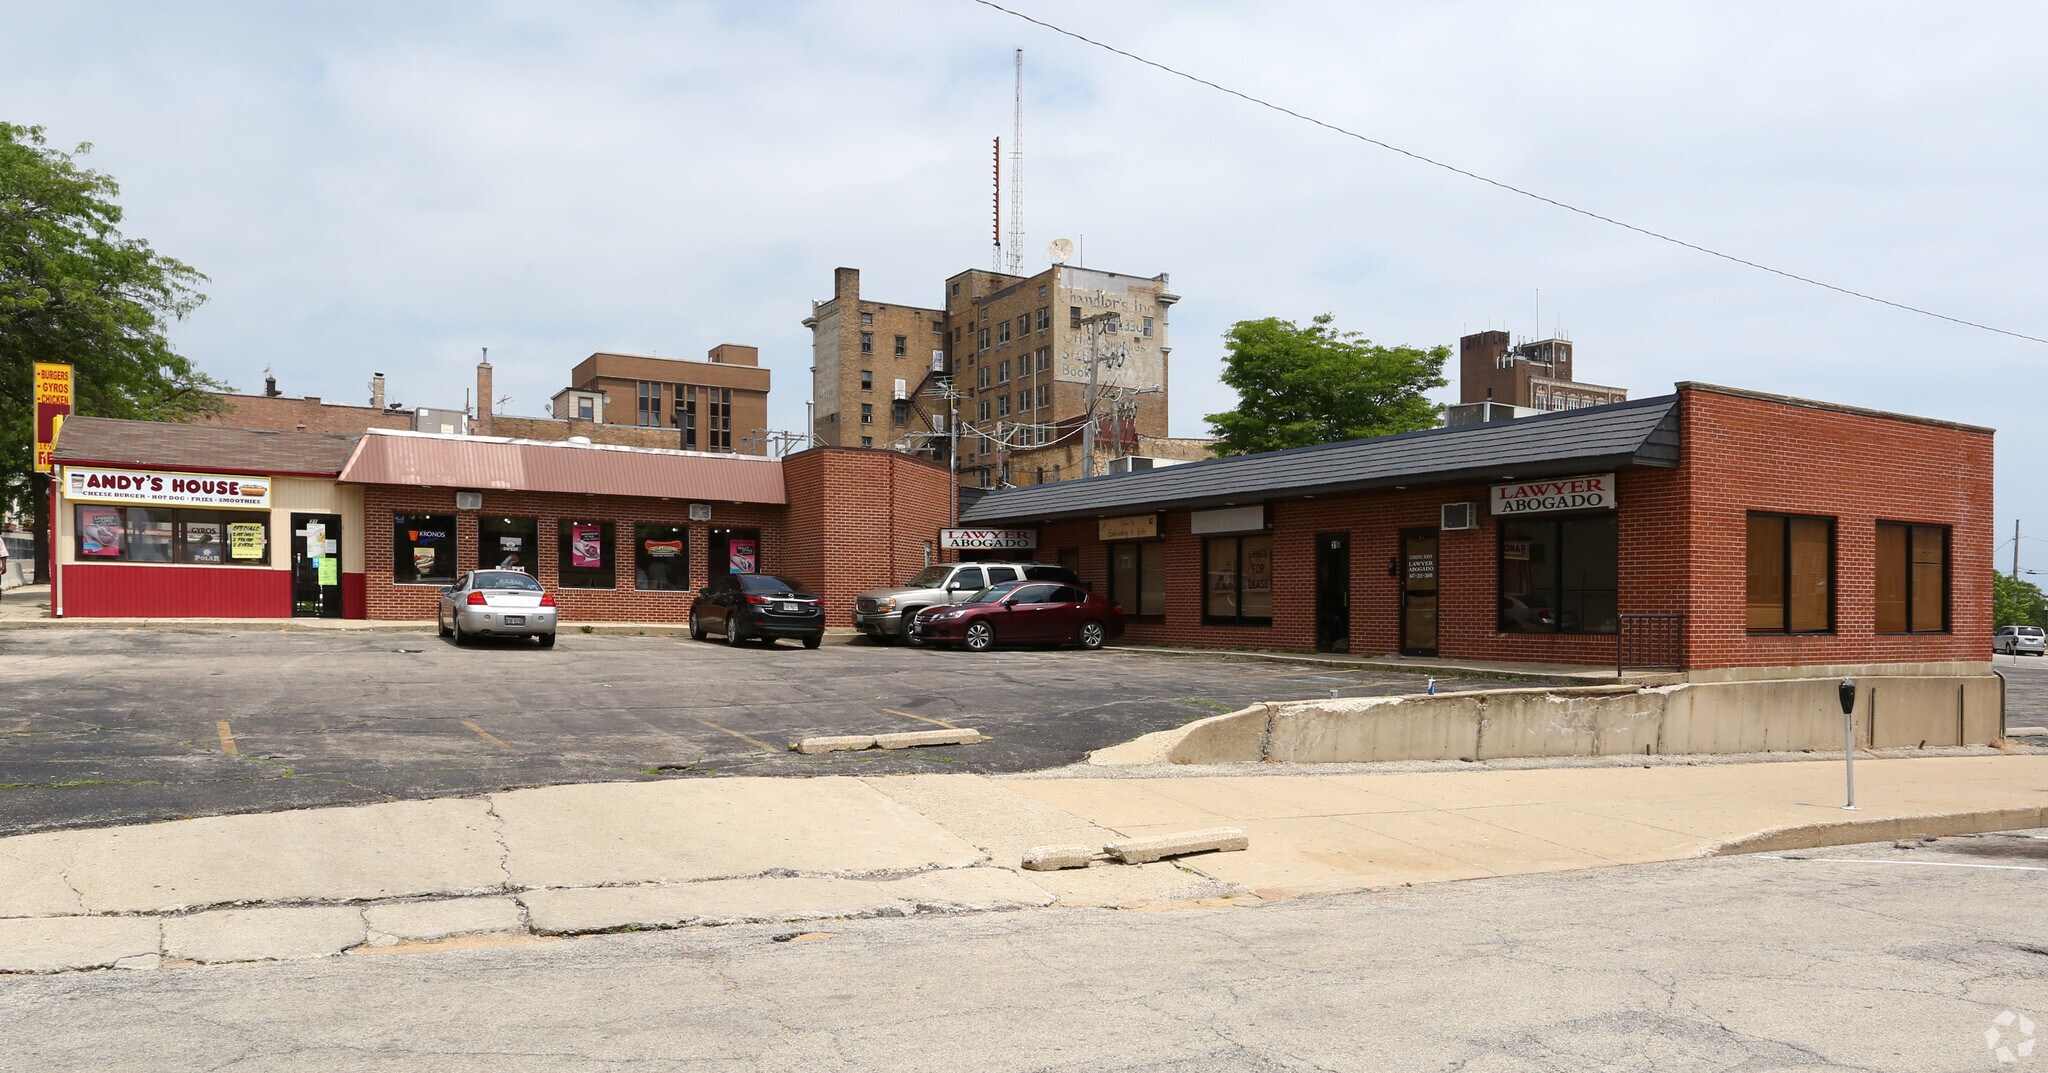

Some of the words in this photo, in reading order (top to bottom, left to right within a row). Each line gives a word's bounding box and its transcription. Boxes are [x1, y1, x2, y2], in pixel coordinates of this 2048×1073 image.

[41, 369, 69, 381] BURGERS
[42, 382, 69, 394] GYROS
[41, 394, 69, 405] CHICKEN
[86, 473, 163, 492] ANDY'S
[172, 478, 240, 496] HOUSE
[1499, 479, 1606, 500] LAWYER
[1501, 493, 1603, 512] ABOGADO
[947, 530, 1031, 539] LAWYER
[950, 539, 1029, 547] ABOGADO
[1252, 563, 1265, 575] FOR
[1248, 579, 1269, 590] LEASE
